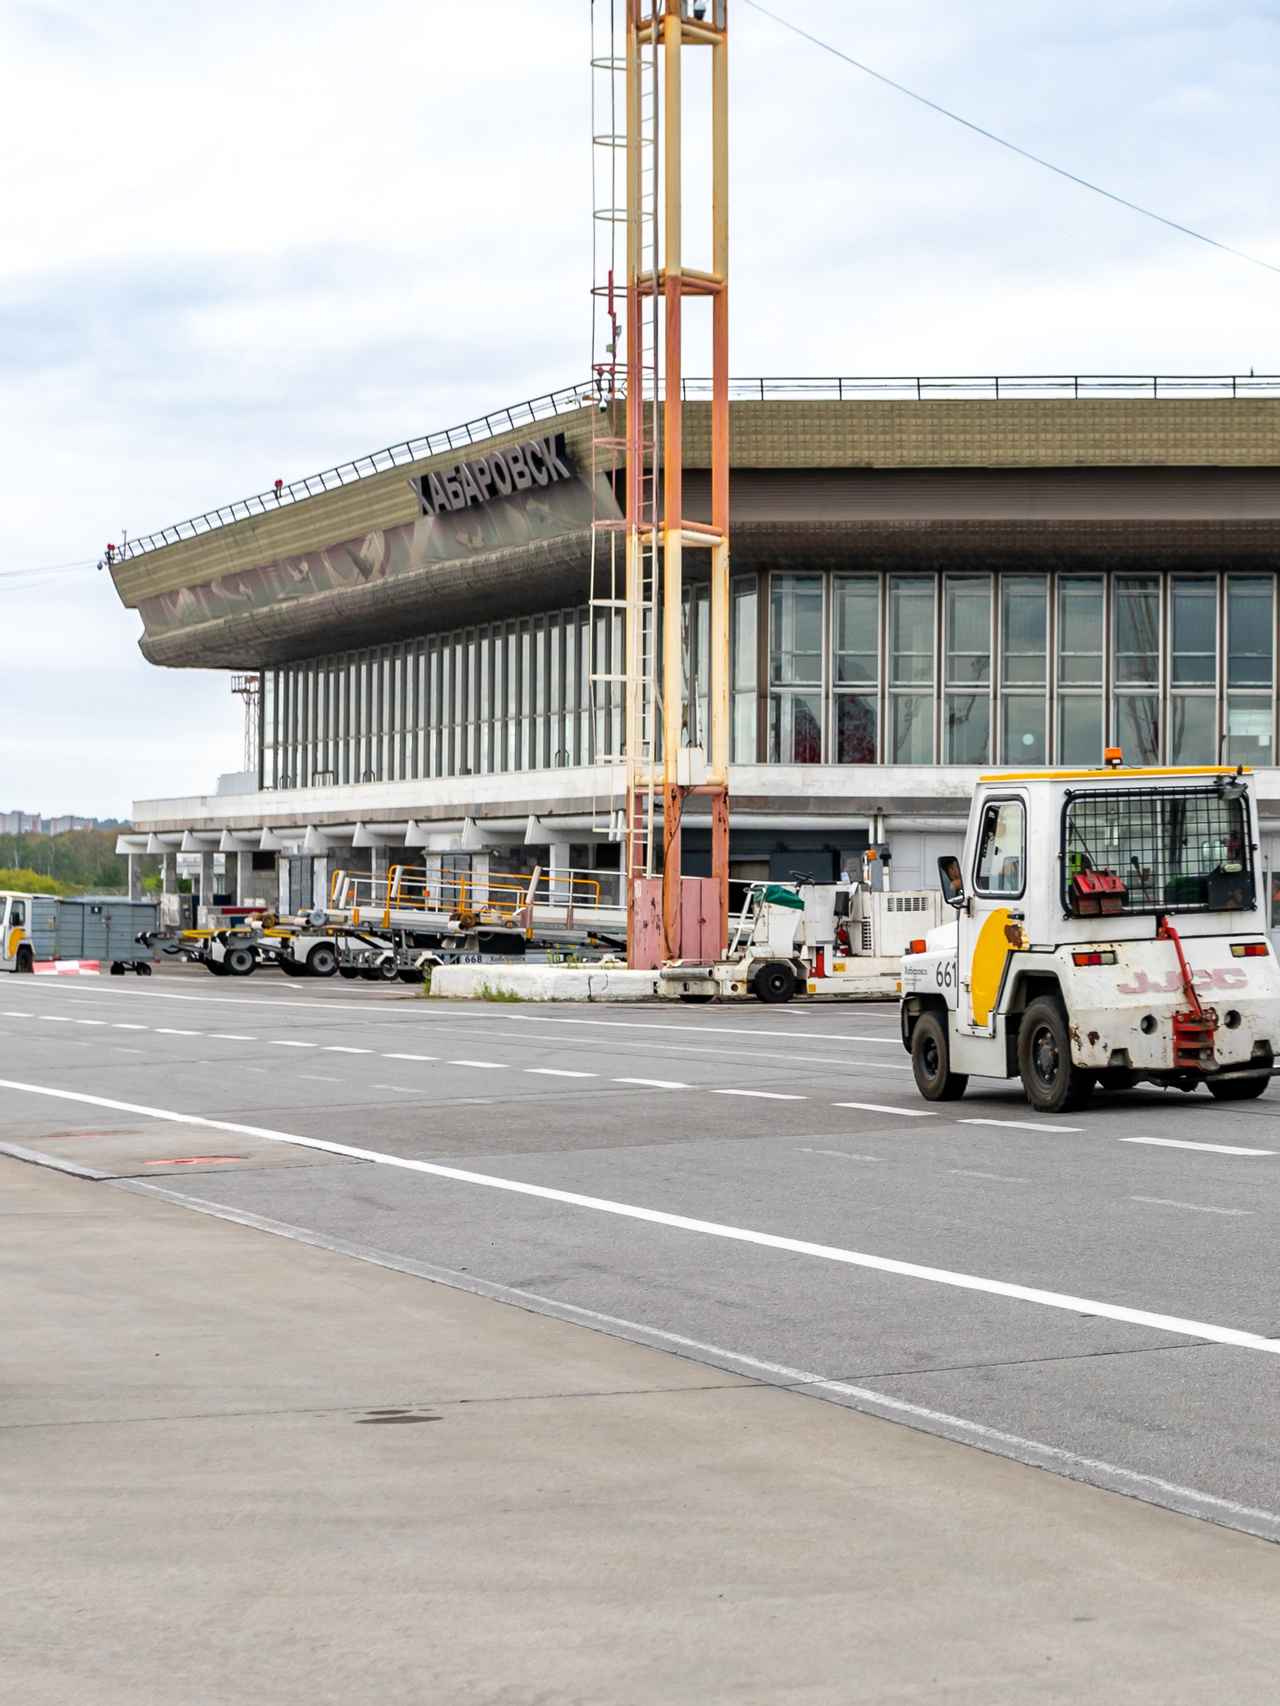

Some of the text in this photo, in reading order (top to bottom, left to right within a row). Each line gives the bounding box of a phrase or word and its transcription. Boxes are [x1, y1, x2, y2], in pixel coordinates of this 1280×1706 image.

[409, 432, 570, 516] ХАБАРОВСК
[465, 955, 482, 963] 668
[936, 961, 957, 988] 661
